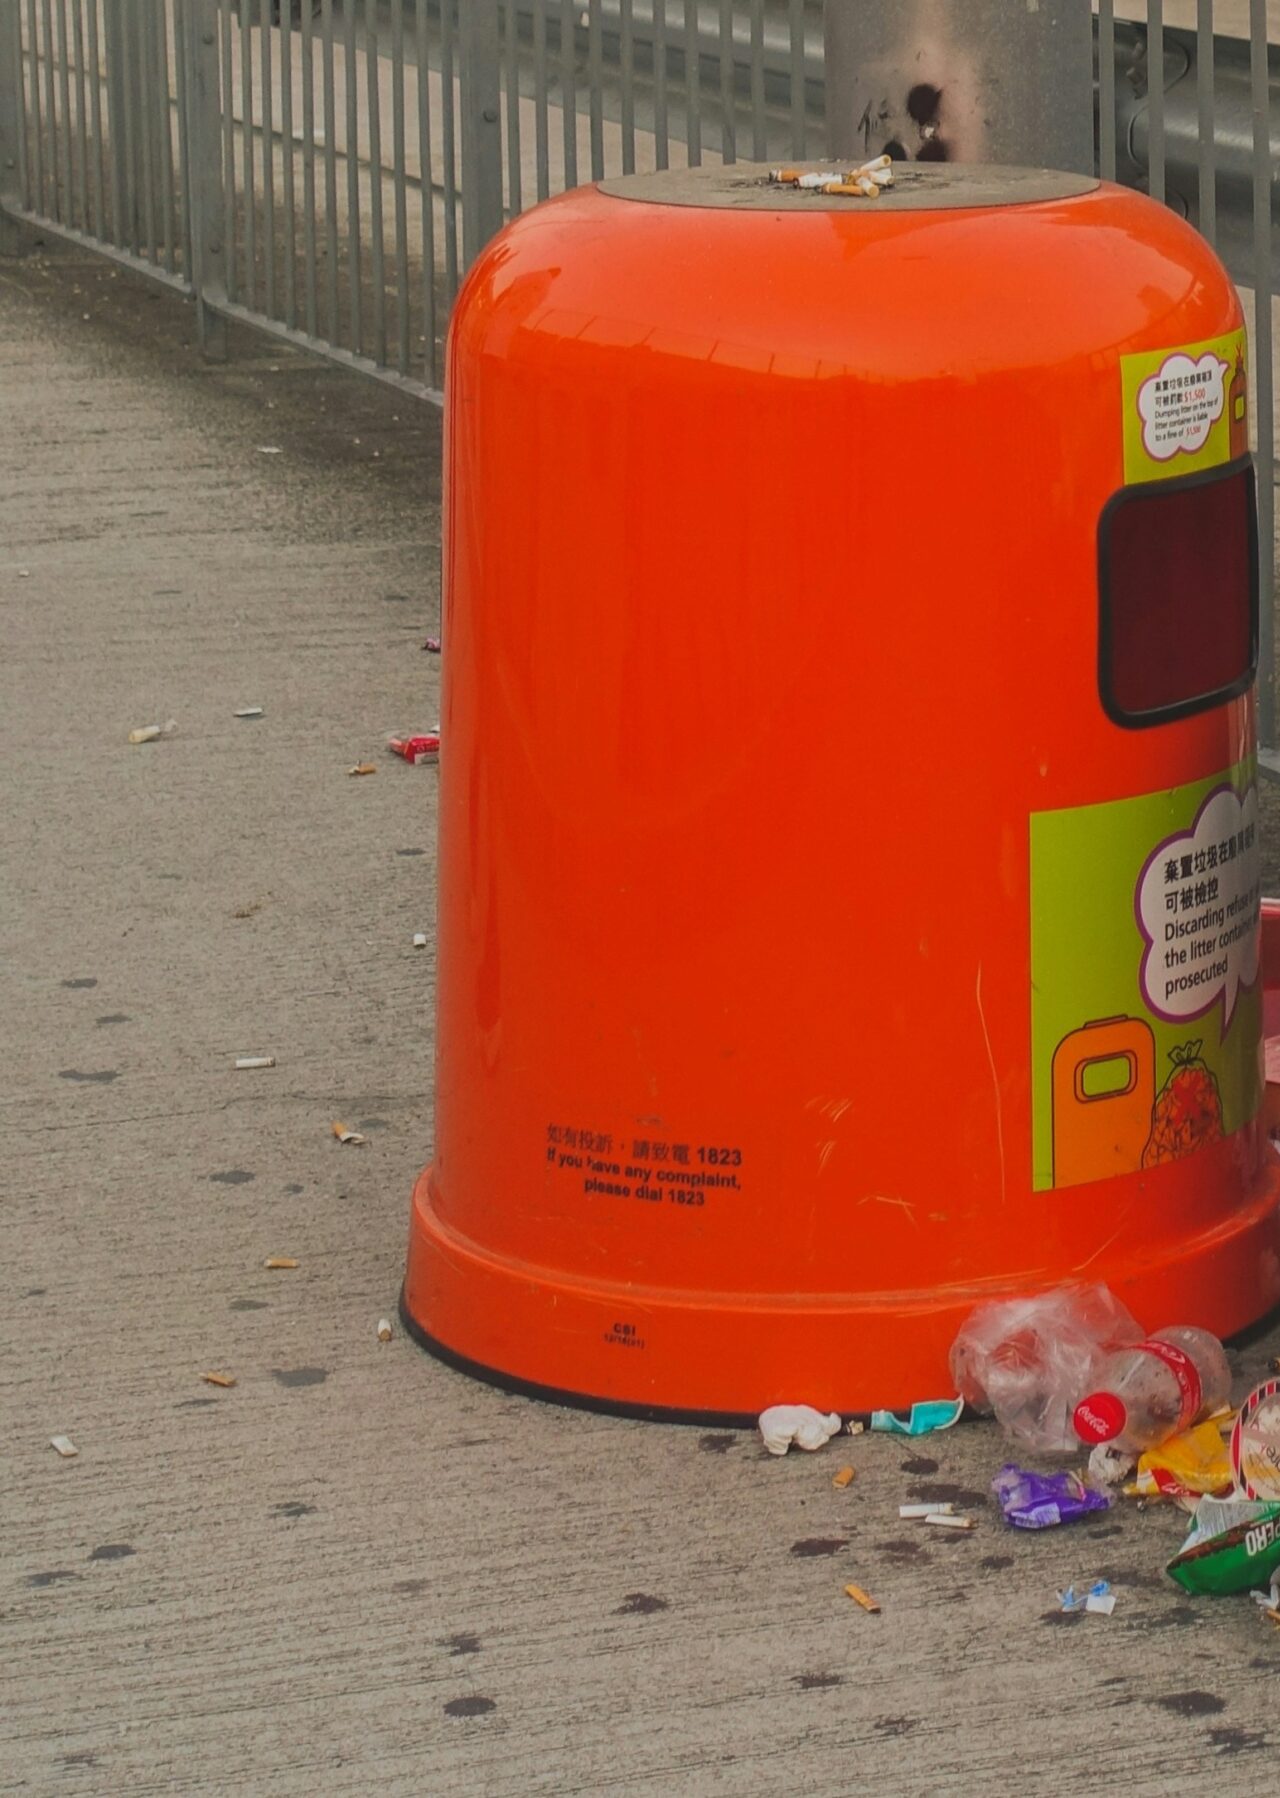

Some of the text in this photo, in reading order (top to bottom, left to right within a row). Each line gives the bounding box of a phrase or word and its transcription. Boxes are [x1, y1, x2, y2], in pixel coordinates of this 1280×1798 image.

[1165, 906, 1225, 942] Discarding
[1165, 947, 1187, 969] the
[1190, 938, 1217, 962] litter
[1165, 958, 1229, 1001] prosecuted
[547, 1147, 741, 1191] If you have any complaint,
[697, 1146, 742, 1167] 1823
[584, 1177, 705, 1206] please dial 1823
